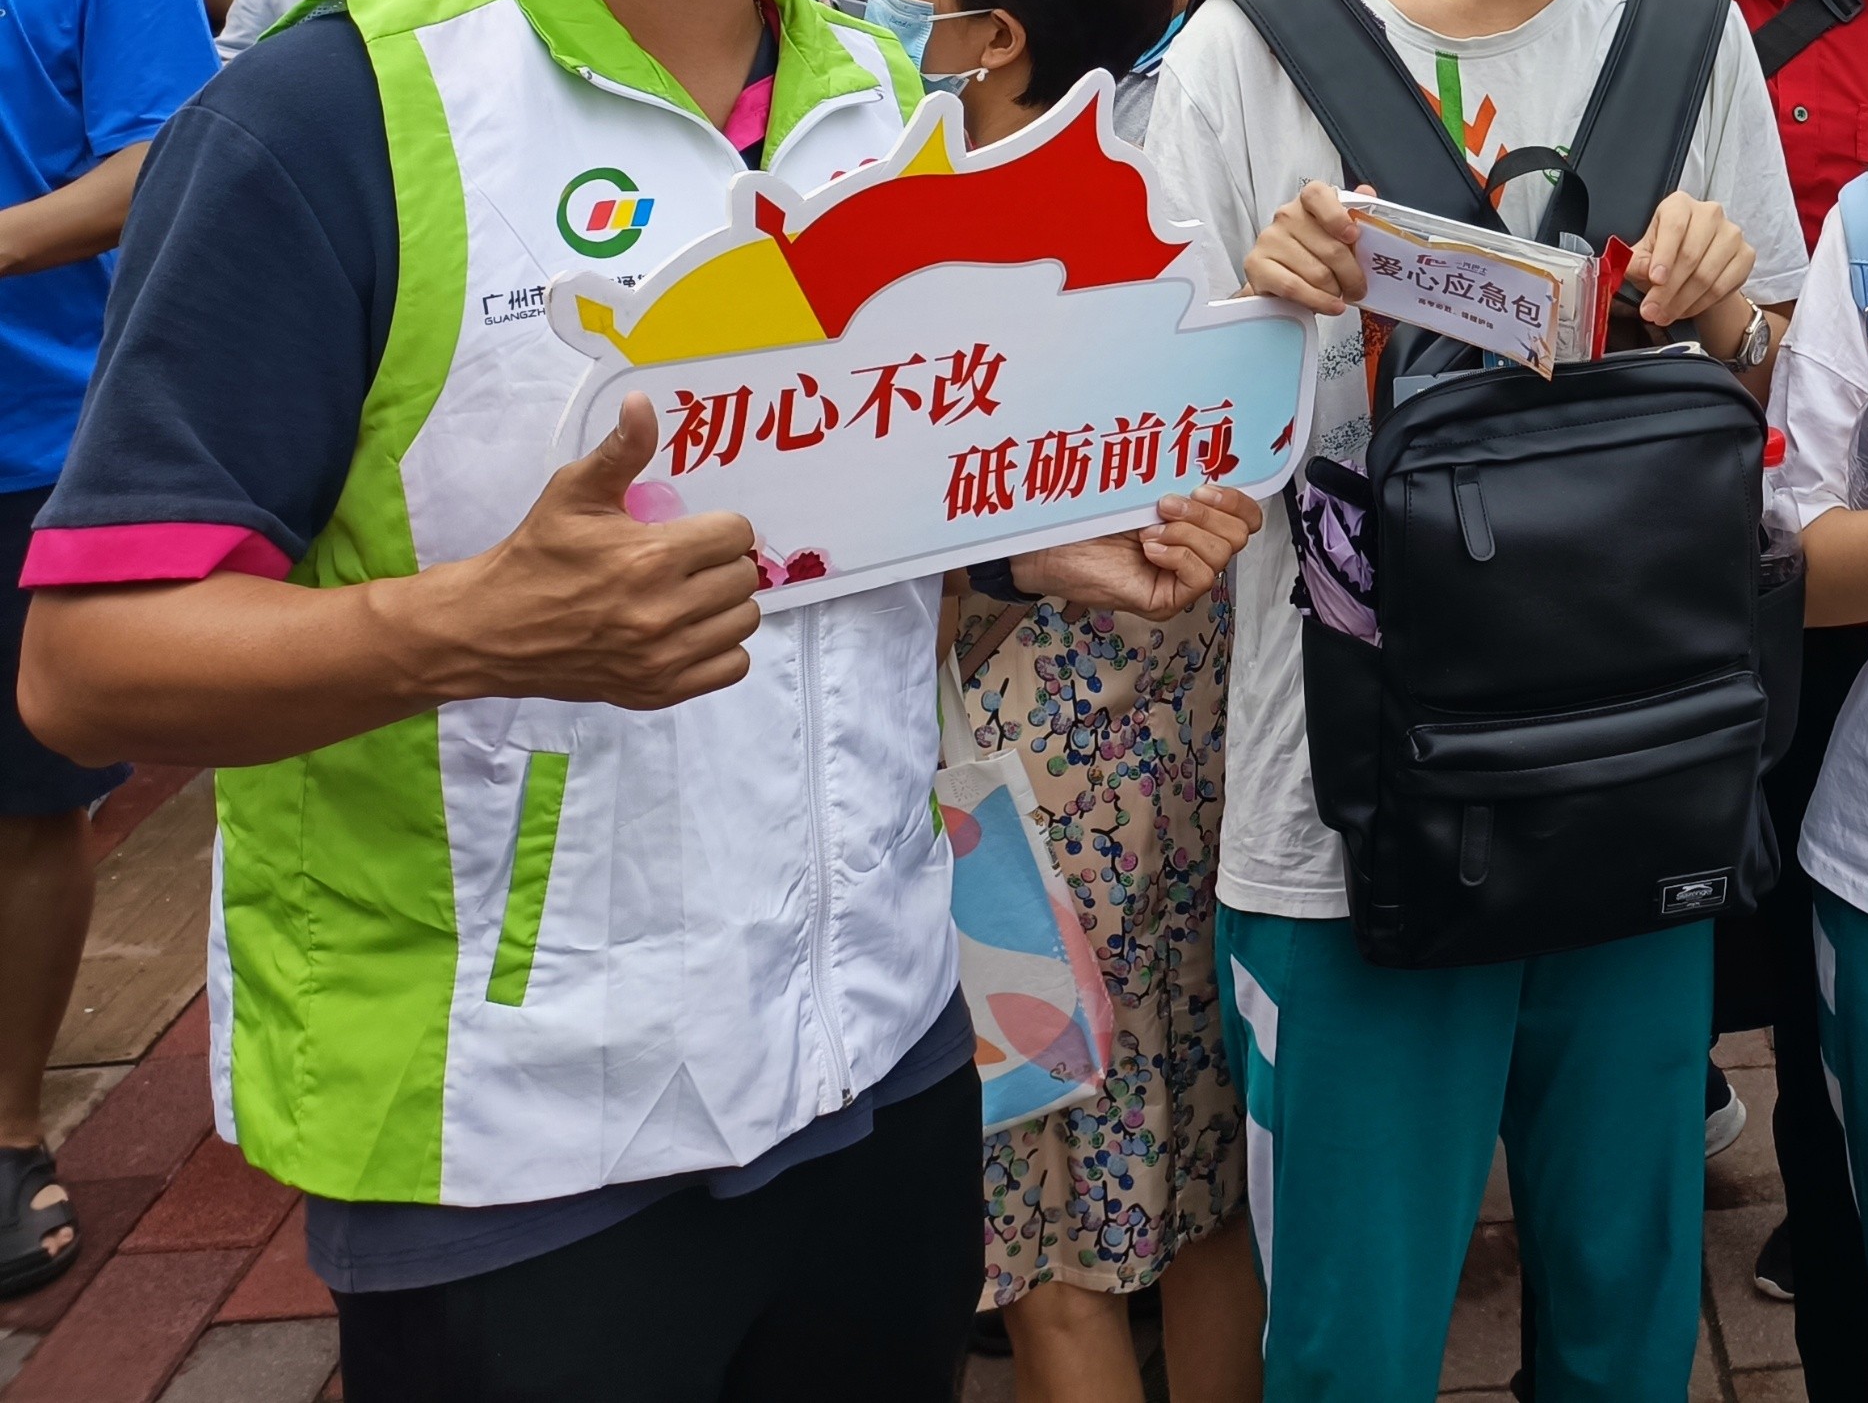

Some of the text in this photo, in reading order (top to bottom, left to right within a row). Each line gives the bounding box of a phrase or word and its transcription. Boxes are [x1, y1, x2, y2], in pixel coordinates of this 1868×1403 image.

[1371, 251, 1542, 329] 爱心应急包
[660, 342, 1008, 478] 初心不改
[943, 398, 1235, 522] 砥砺前行
